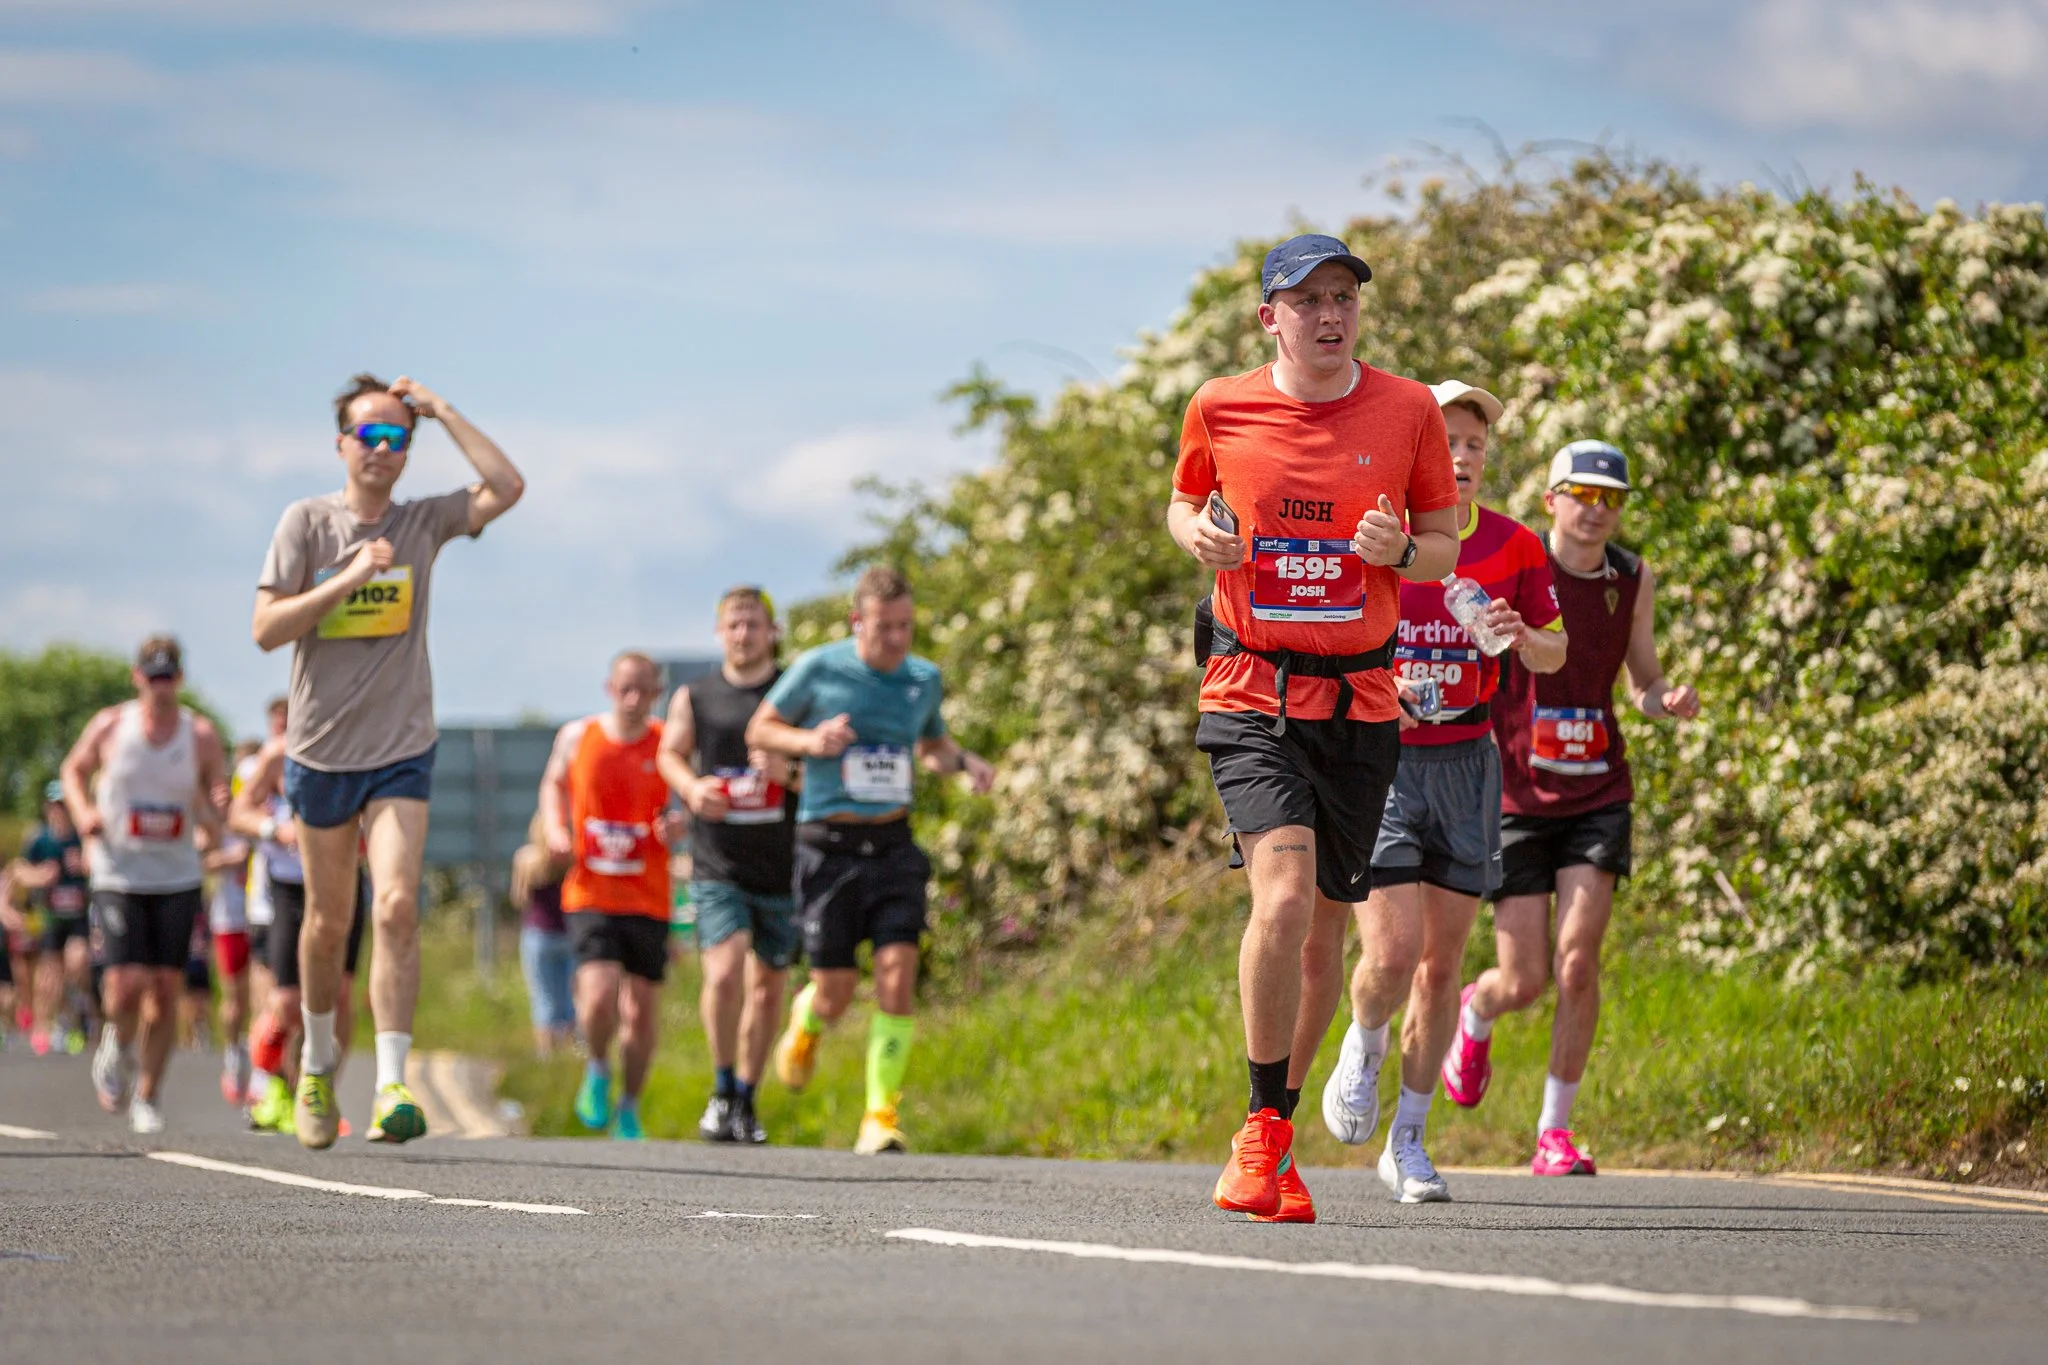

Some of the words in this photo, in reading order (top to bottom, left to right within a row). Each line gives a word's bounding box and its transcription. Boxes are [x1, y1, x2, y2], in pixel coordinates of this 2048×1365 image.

[1279, 499, 1335, 522] JOSH
[1275, 555, 1342, 580] 1595
[1290, 584, 1326, 597] JOSH
[1399, 661, 1462, 685] 1850
[1556, 720, 1594, 743] 861
